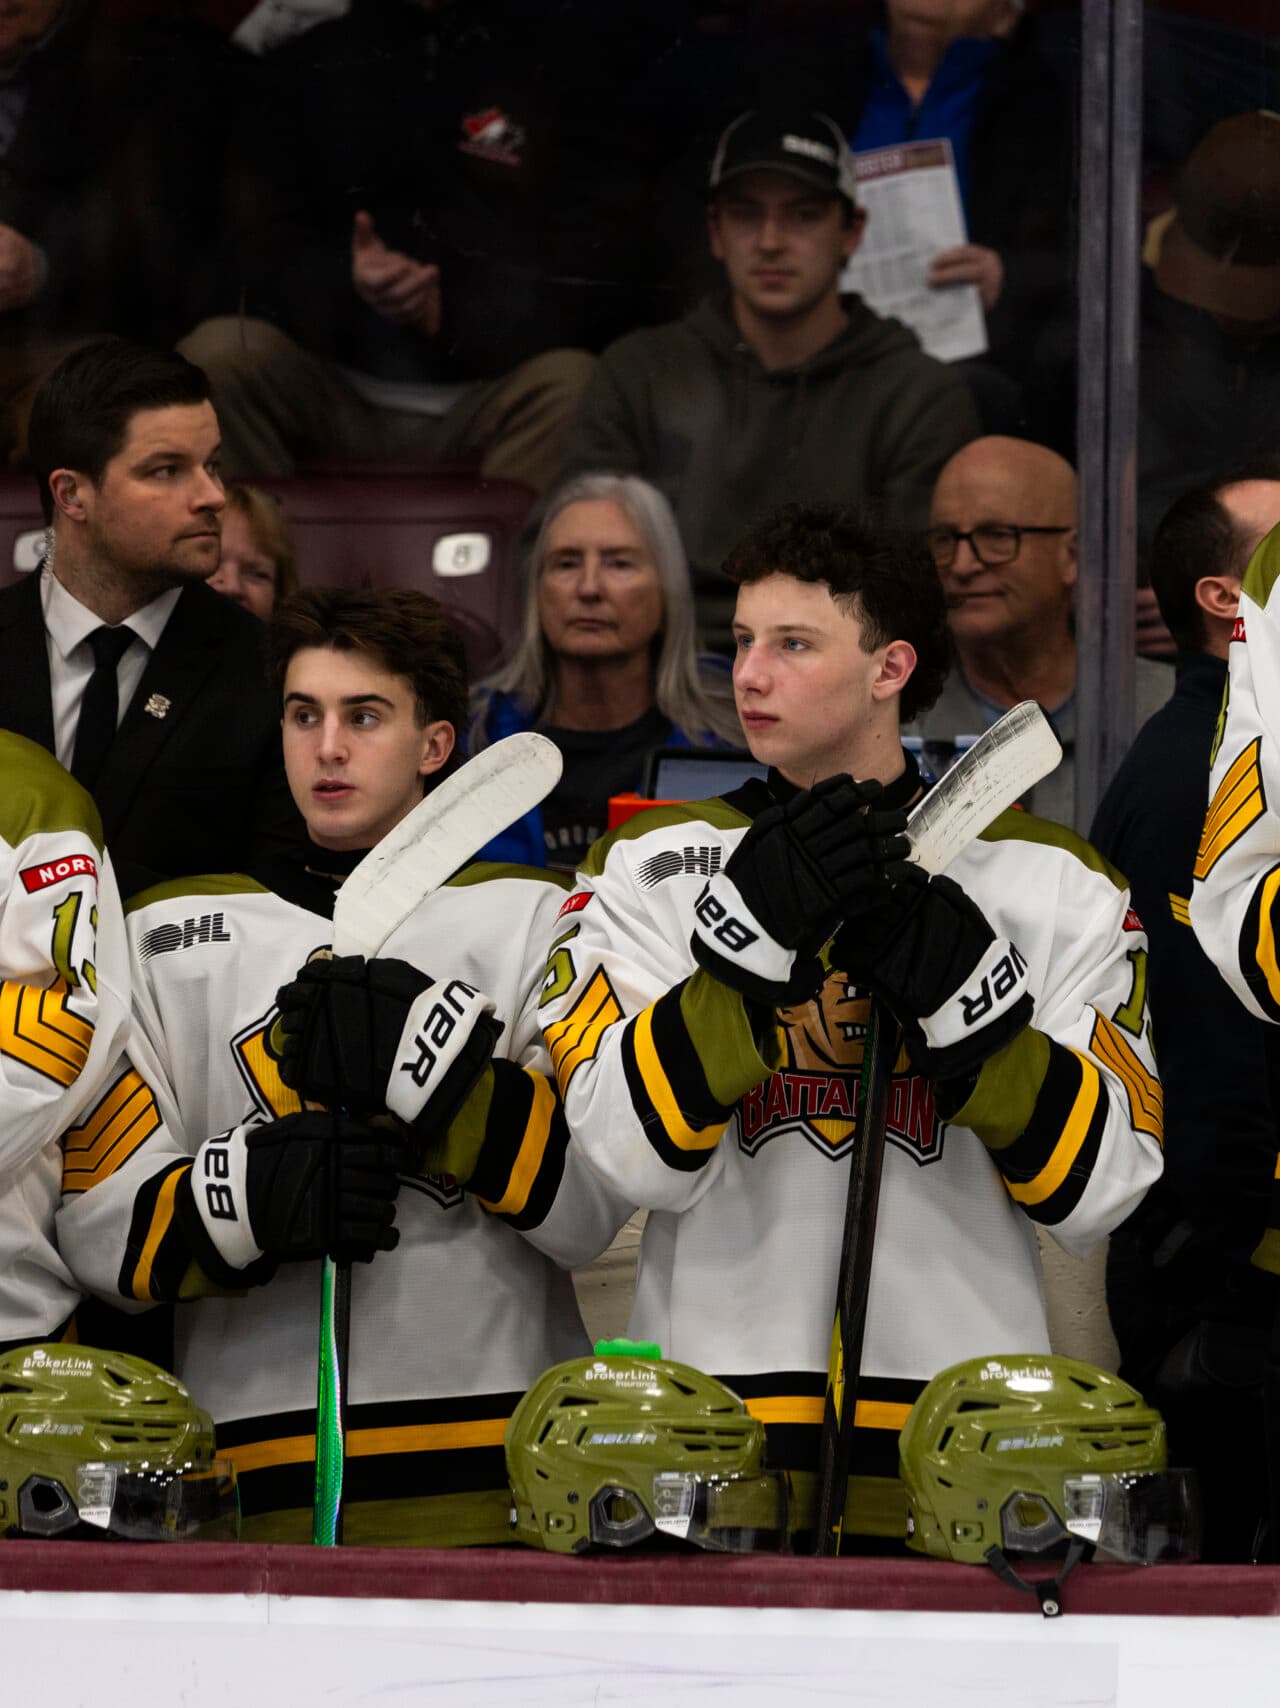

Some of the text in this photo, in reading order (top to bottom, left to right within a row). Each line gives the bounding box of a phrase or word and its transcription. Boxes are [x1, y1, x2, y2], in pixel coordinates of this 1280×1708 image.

[52, 891, 98, 996] 1
[136, 912, 231, 965] OHL
[1111, 947, 1159, 1061] 1
[742, 1072, 937, 1149] BATTAON
[23, 1356, 94, 1370] BrokerLink
[51, 1368, 93, 1377] Insurance
[585, 1368, 658, 1382] BrokerLink
[980, 1367, 1053, 1381] BrokerLink
[615, 1380, 658, 1389] Insurance
[590, 1432, 658, 1445] BAUER
[997, 1433, 1065, 1452] BAUER
